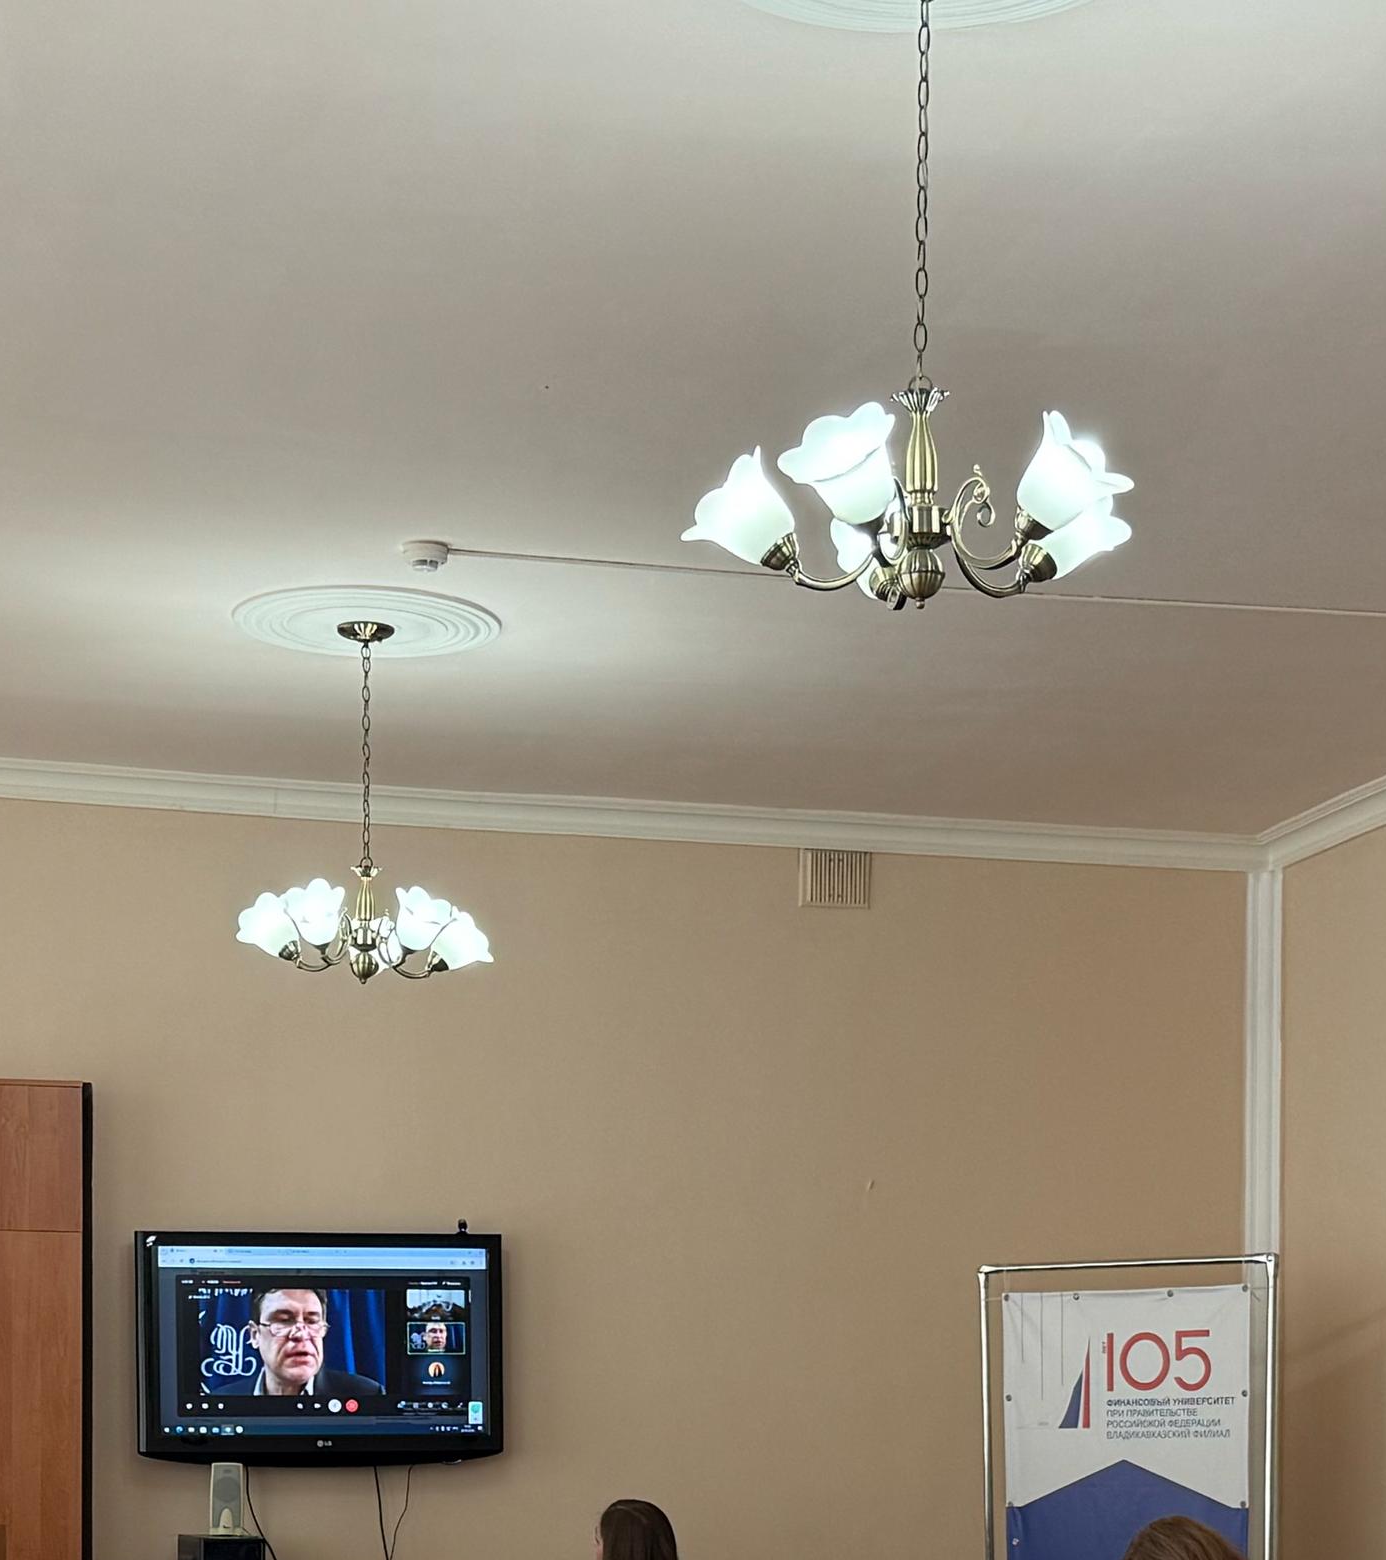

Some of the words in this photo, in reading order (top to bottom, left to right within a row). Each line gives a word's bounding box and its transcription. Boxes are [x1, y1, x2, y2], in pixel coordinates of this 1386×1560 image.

[1106, 1329, 1212, 1392] 105
[1106, 1396, 1171, 1407] ФИНАНСОВЫЙ
[1172, 1396, 1236, 1406] УНИВЕРСИТЕТ
[1106, 1409, 1125, 1418] ПРИ
[1126, 1408, 1198, 1417] ПРАВИТЕЛЬСТВЕ
[1106, 1418, 1166, 1429] РОССИЙСКОЙ
[1167, 1418, 1222, 1429] ФЕДЕРАЦИИ
[1106, 1428, 1191, 1440] ВЛАДИКАВКАЗСКИЙ
[1192, 1428, 1231, 1439] ФИЛИАЛ
